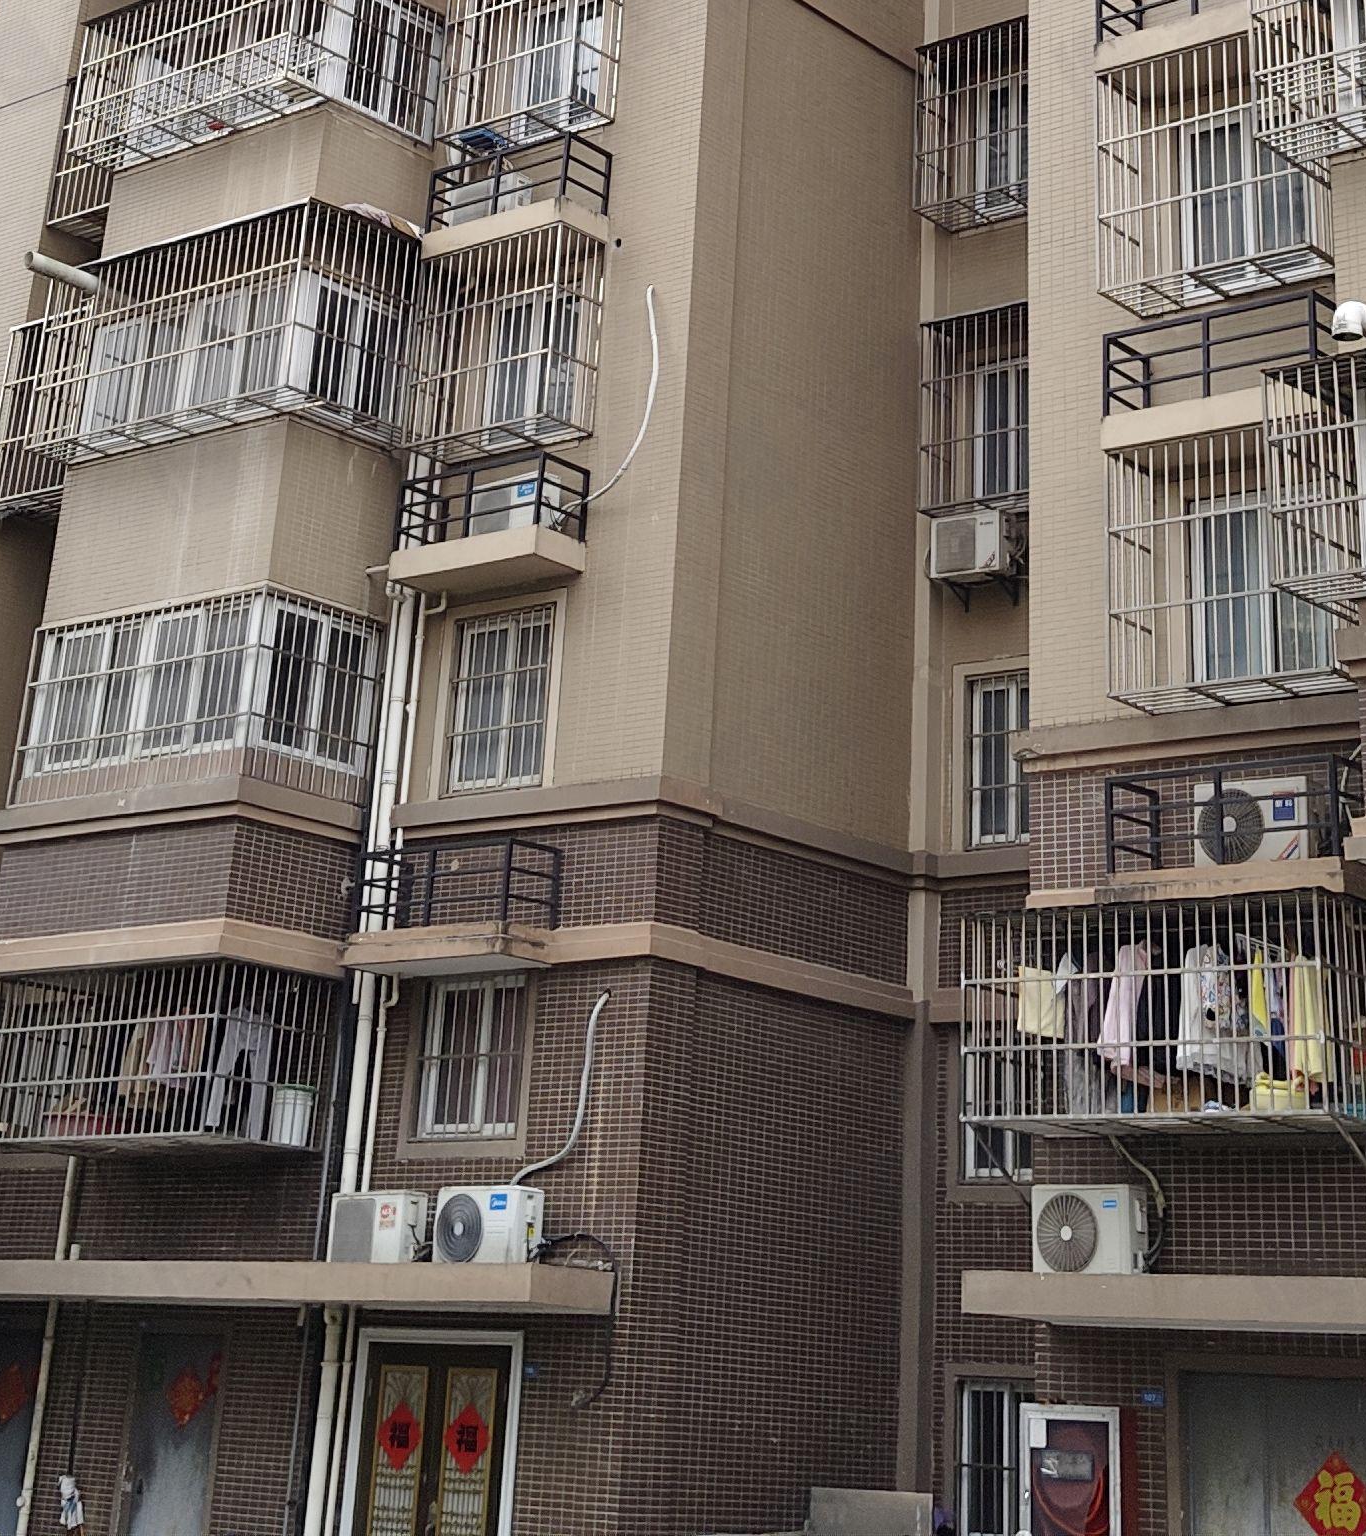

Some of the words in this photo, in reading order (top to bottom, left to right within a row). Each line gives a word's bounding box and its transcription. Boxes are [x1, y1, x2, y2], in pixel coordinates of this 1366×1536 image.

[388, 1422, 410, 1449] 福
[456, 1424, 478, 1453] 福
[1314, 1470, 1362, 1532] 福
